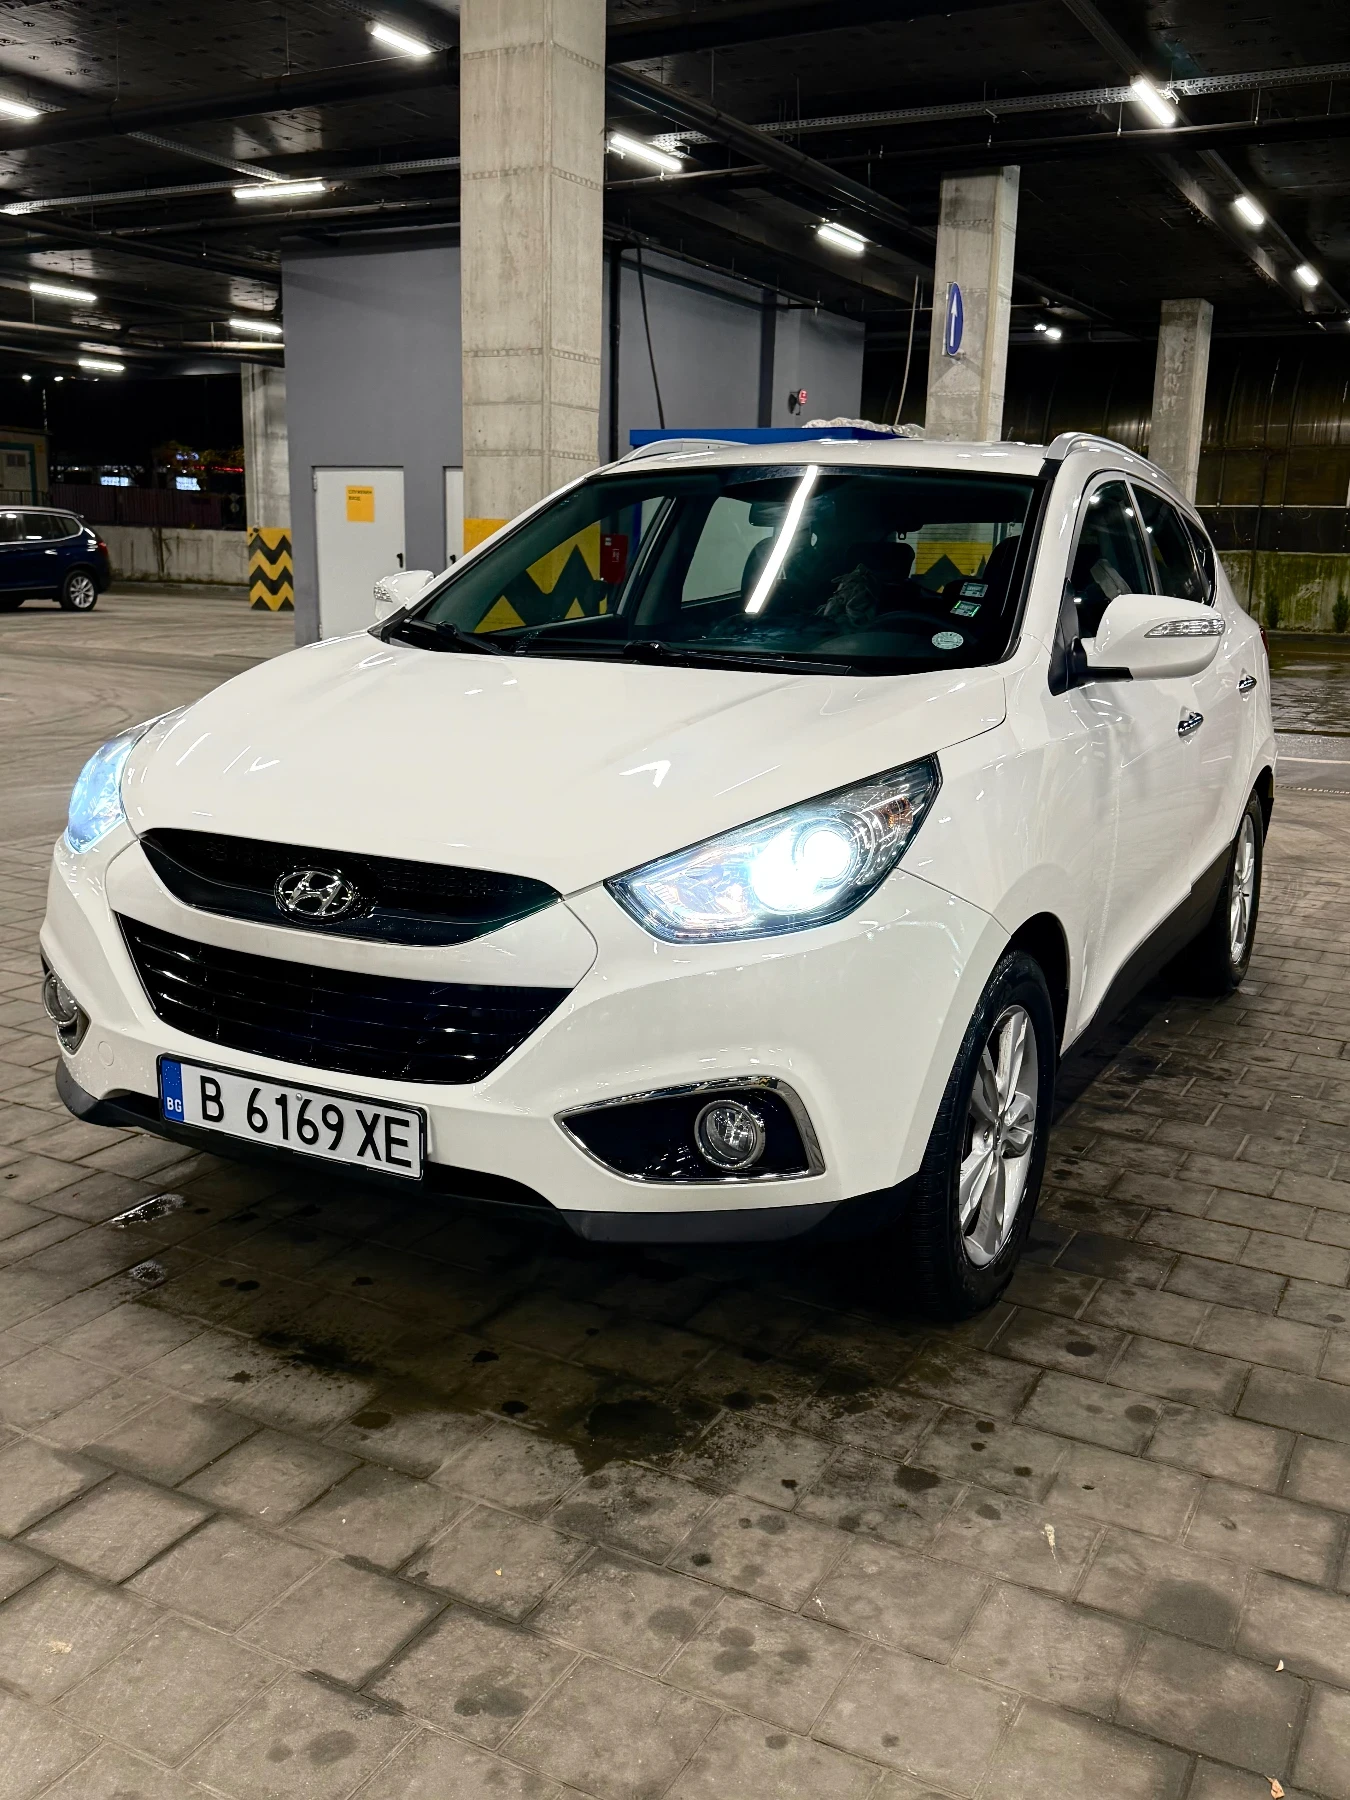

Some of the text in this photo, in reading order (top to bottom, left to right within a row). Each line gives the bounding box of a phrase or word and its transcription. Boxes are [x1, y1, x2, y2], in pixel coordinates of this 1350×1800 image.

[166, 1096, 182, 1112] BG
[200, 1075, 412, 1169] B 6169 XE
